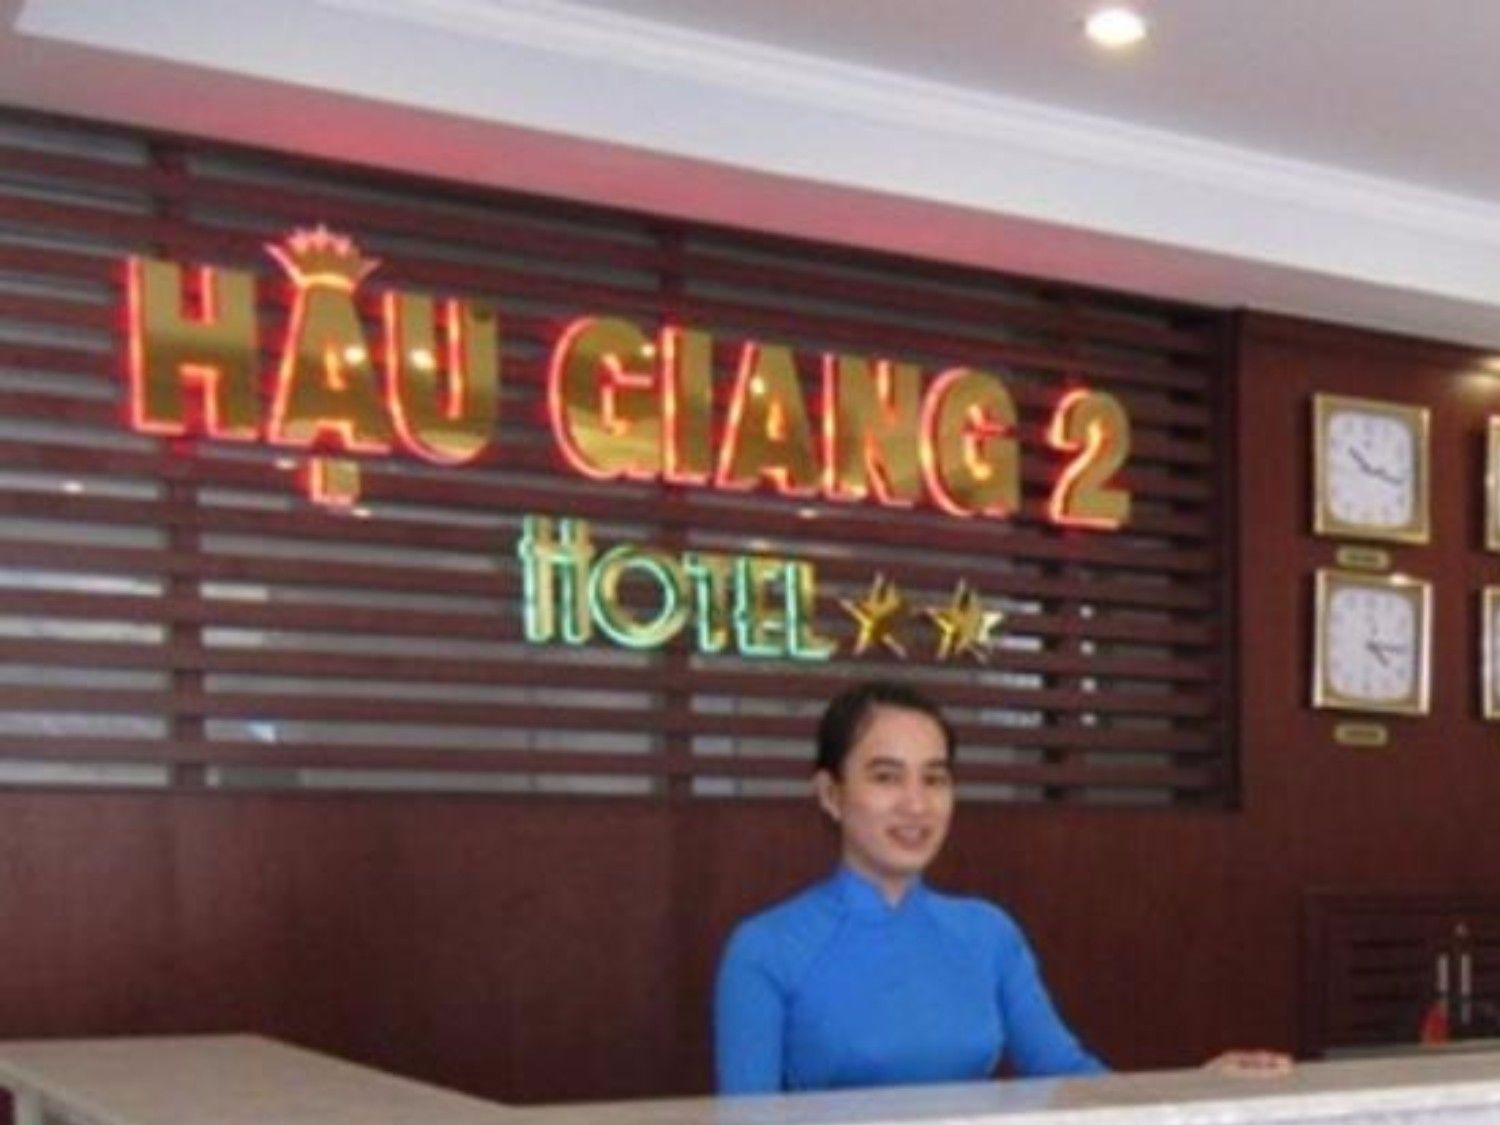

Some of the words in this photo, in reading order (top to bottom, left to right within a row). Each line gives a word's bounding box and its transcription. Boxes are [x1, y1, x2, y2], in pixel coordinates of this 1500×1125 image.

[547, 314, 1022, 519] GIANG
[1046, 388, 1132, 529] 2
[518, 515, 838, 660] HOTEL
